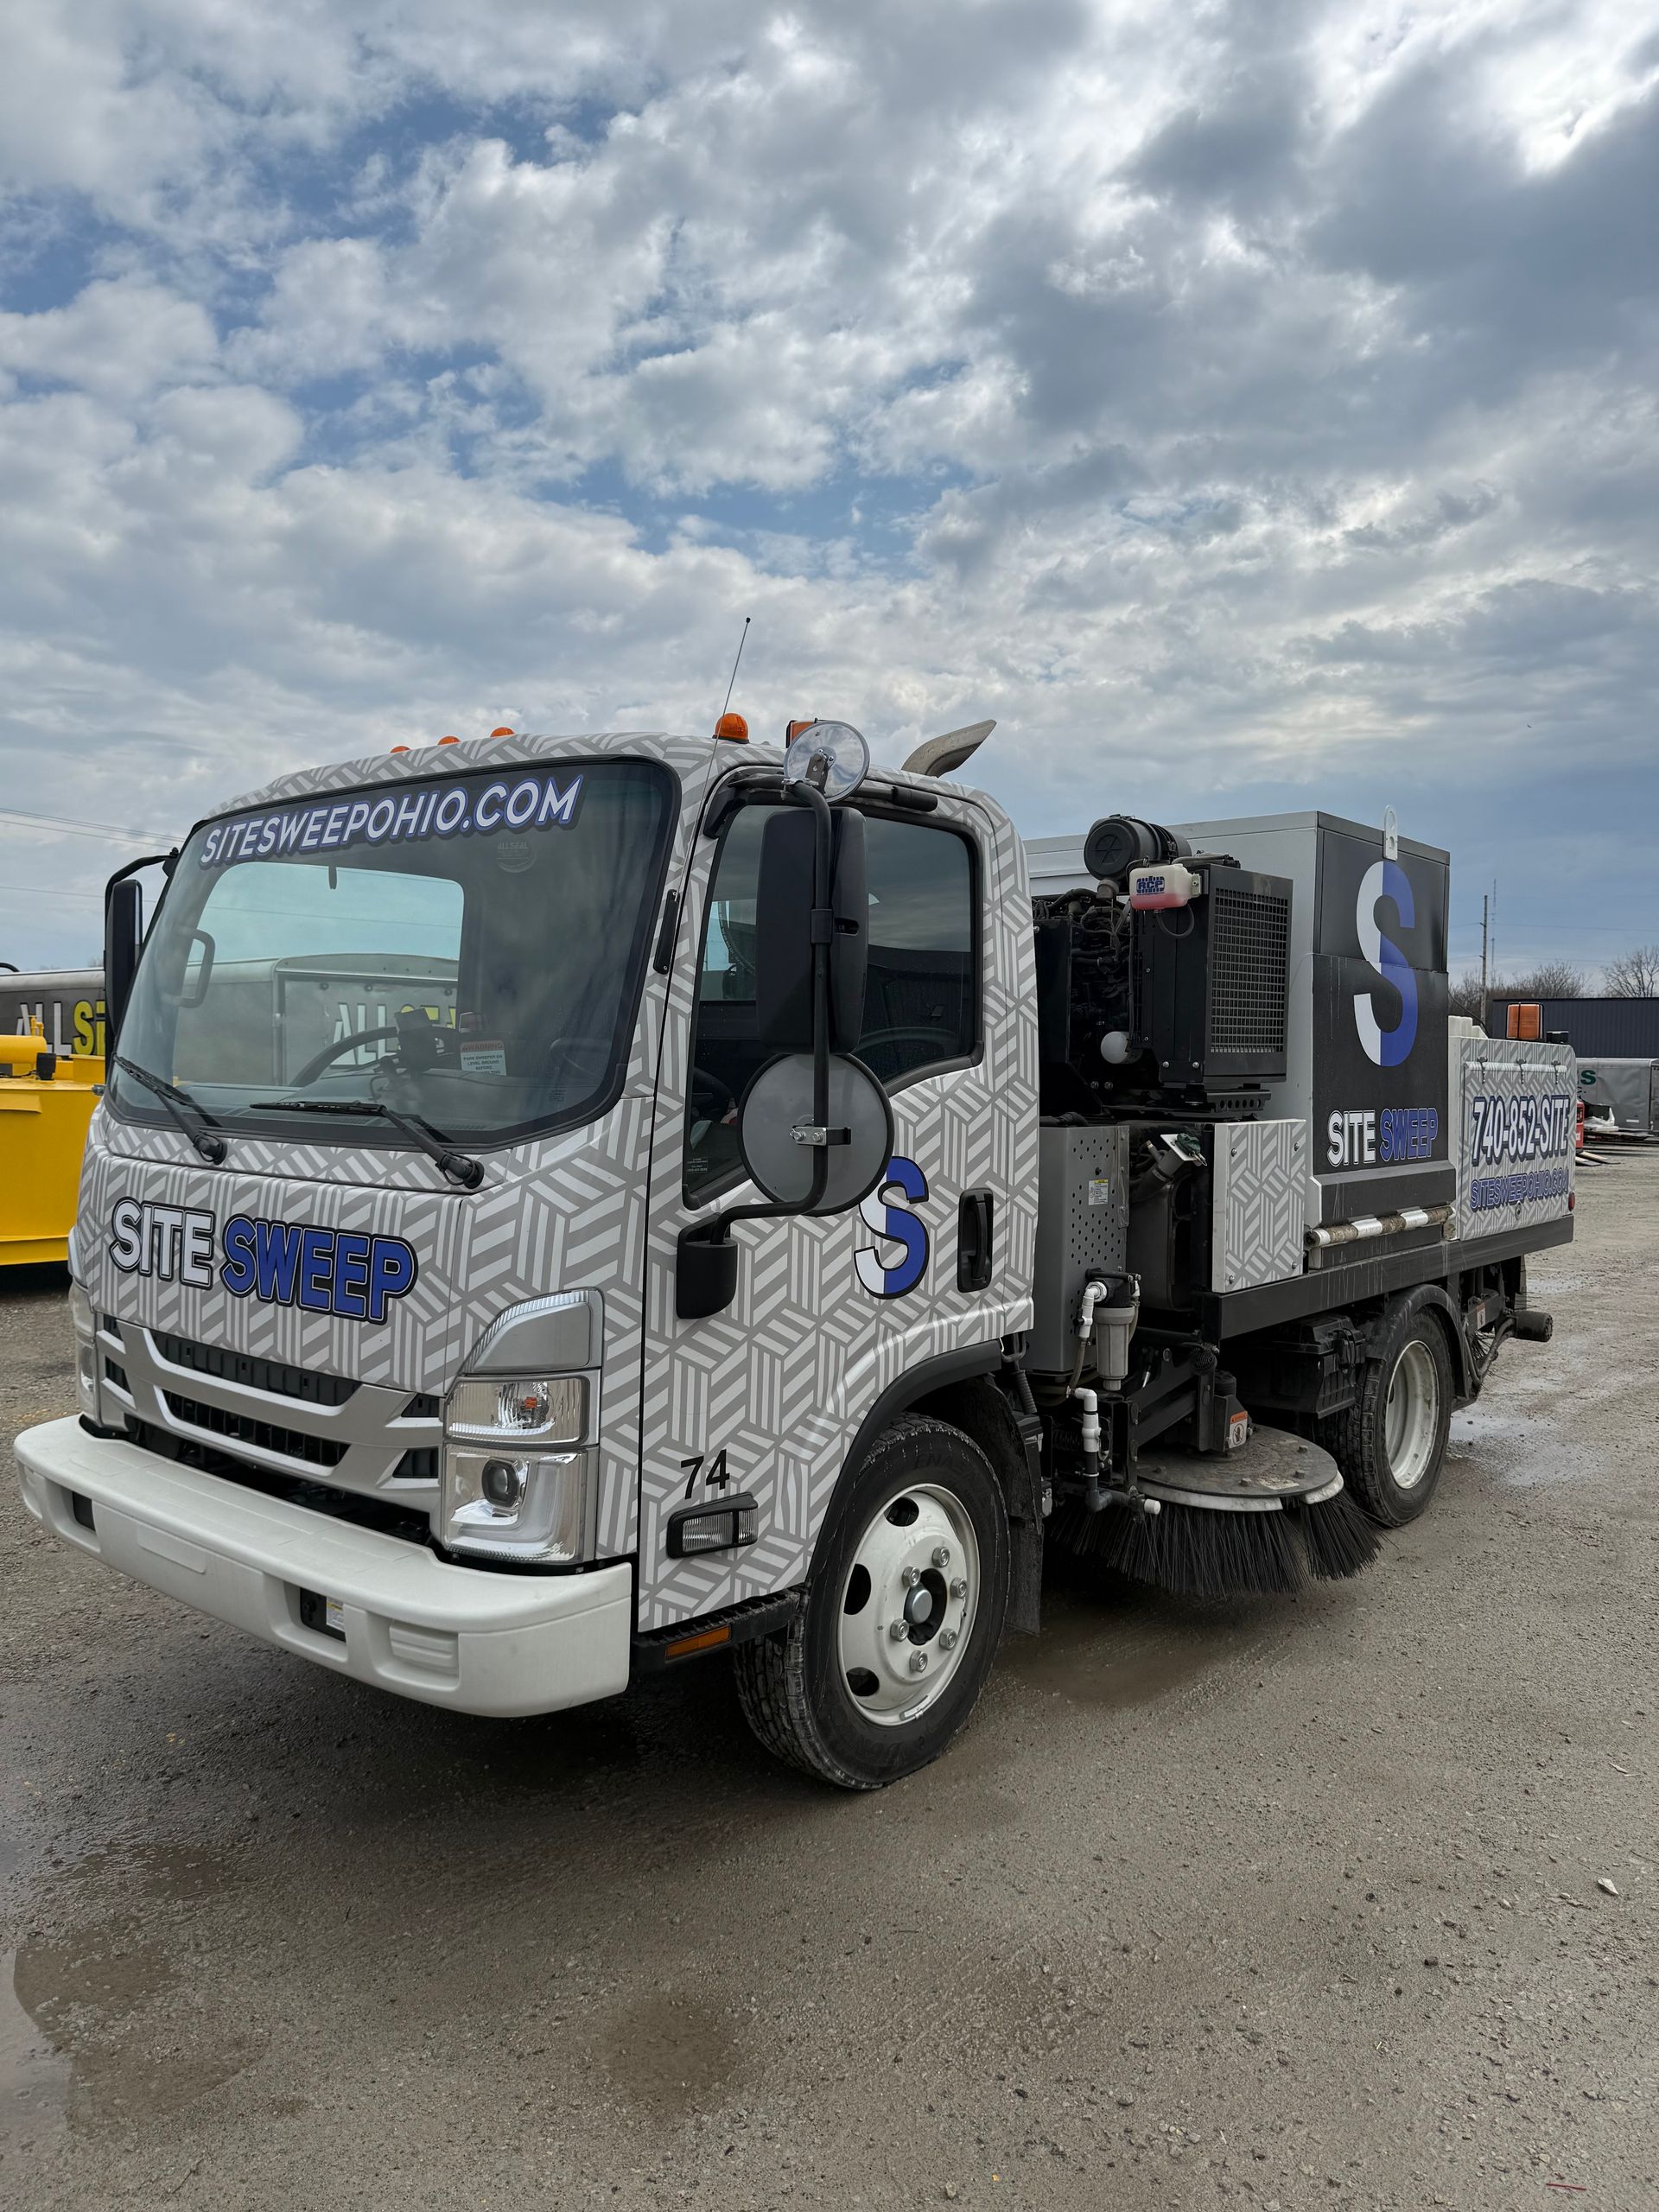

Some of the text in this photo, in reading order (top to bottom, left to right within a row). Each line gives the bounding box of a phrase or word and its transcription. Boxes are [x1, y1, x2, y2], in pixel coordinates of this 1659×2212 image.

[200, 775, 583, 864] SITESWEEPOHIO.COM
[1354, 861, 1418, 1066] S
[1327, 1108, 1438, 1167] SITE SWEEP
[1472, 1096, 1569, 1163] 740-852-SITE
[110, 1198, 416, 1323] SITE SWEEP
[854, 1156, 930, 1300] S
[681, 1449, 730, 1500] 74
